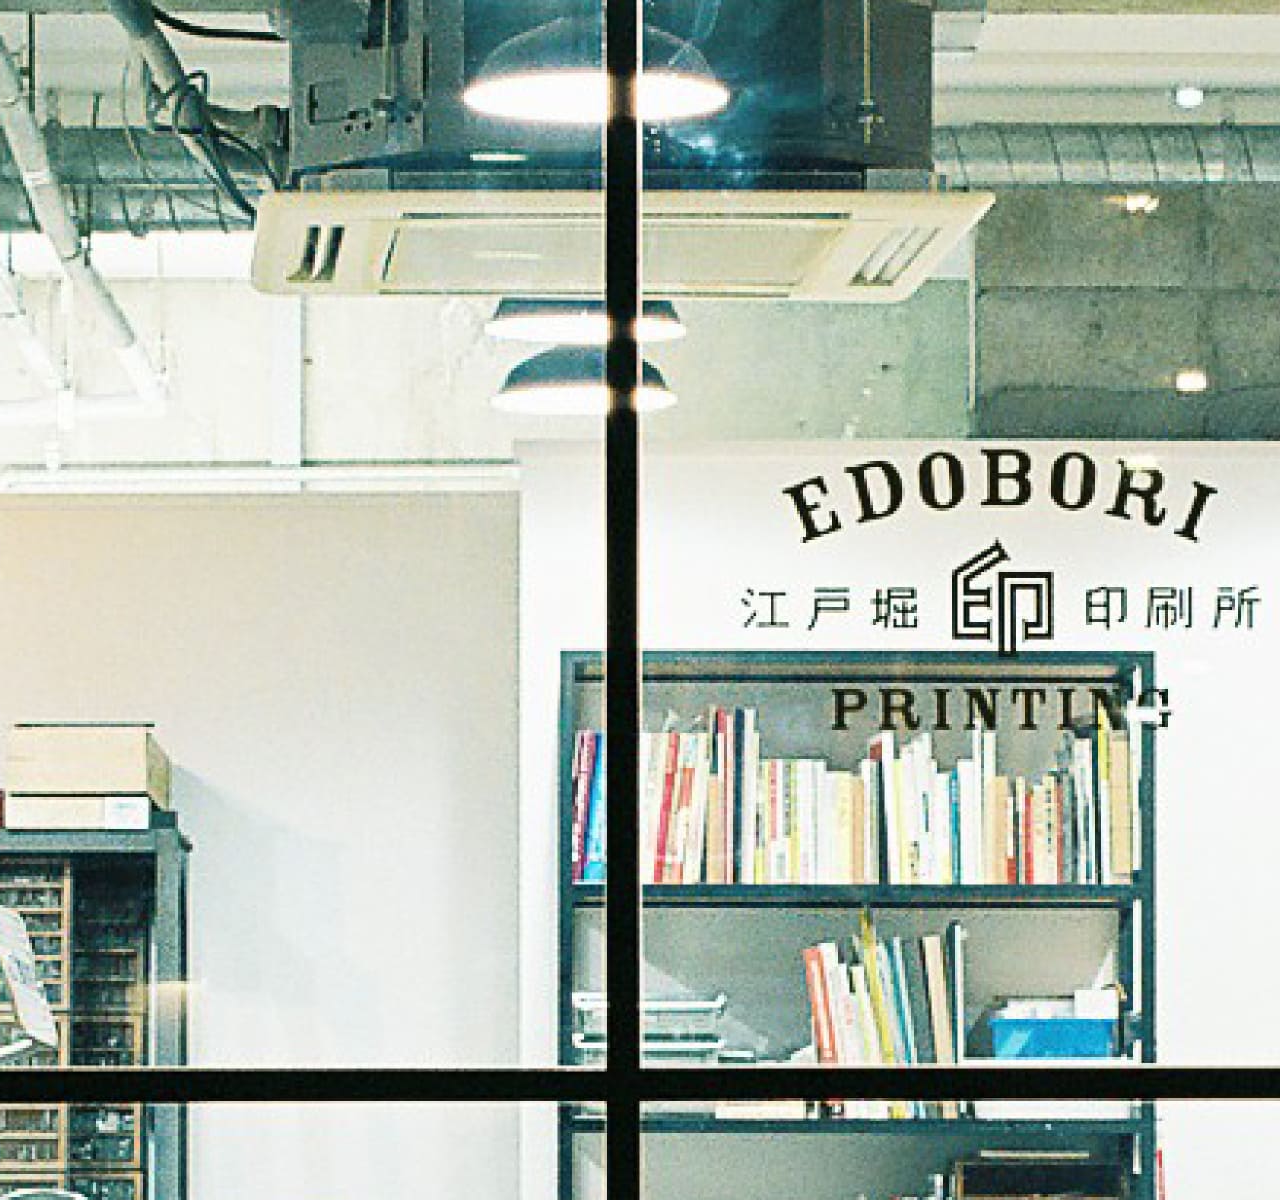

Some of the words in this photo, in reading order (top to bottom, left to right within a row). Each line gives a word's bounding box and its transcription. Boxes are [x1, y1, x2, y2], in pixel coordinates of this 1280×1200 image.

[782, 448, 1218, 542] EDOBORI
[741, 586, 919, 631] 江戸堀
[1085, 585, 1261, 630] 印刷所
[831, 687, 1172, 731] PRINTING
